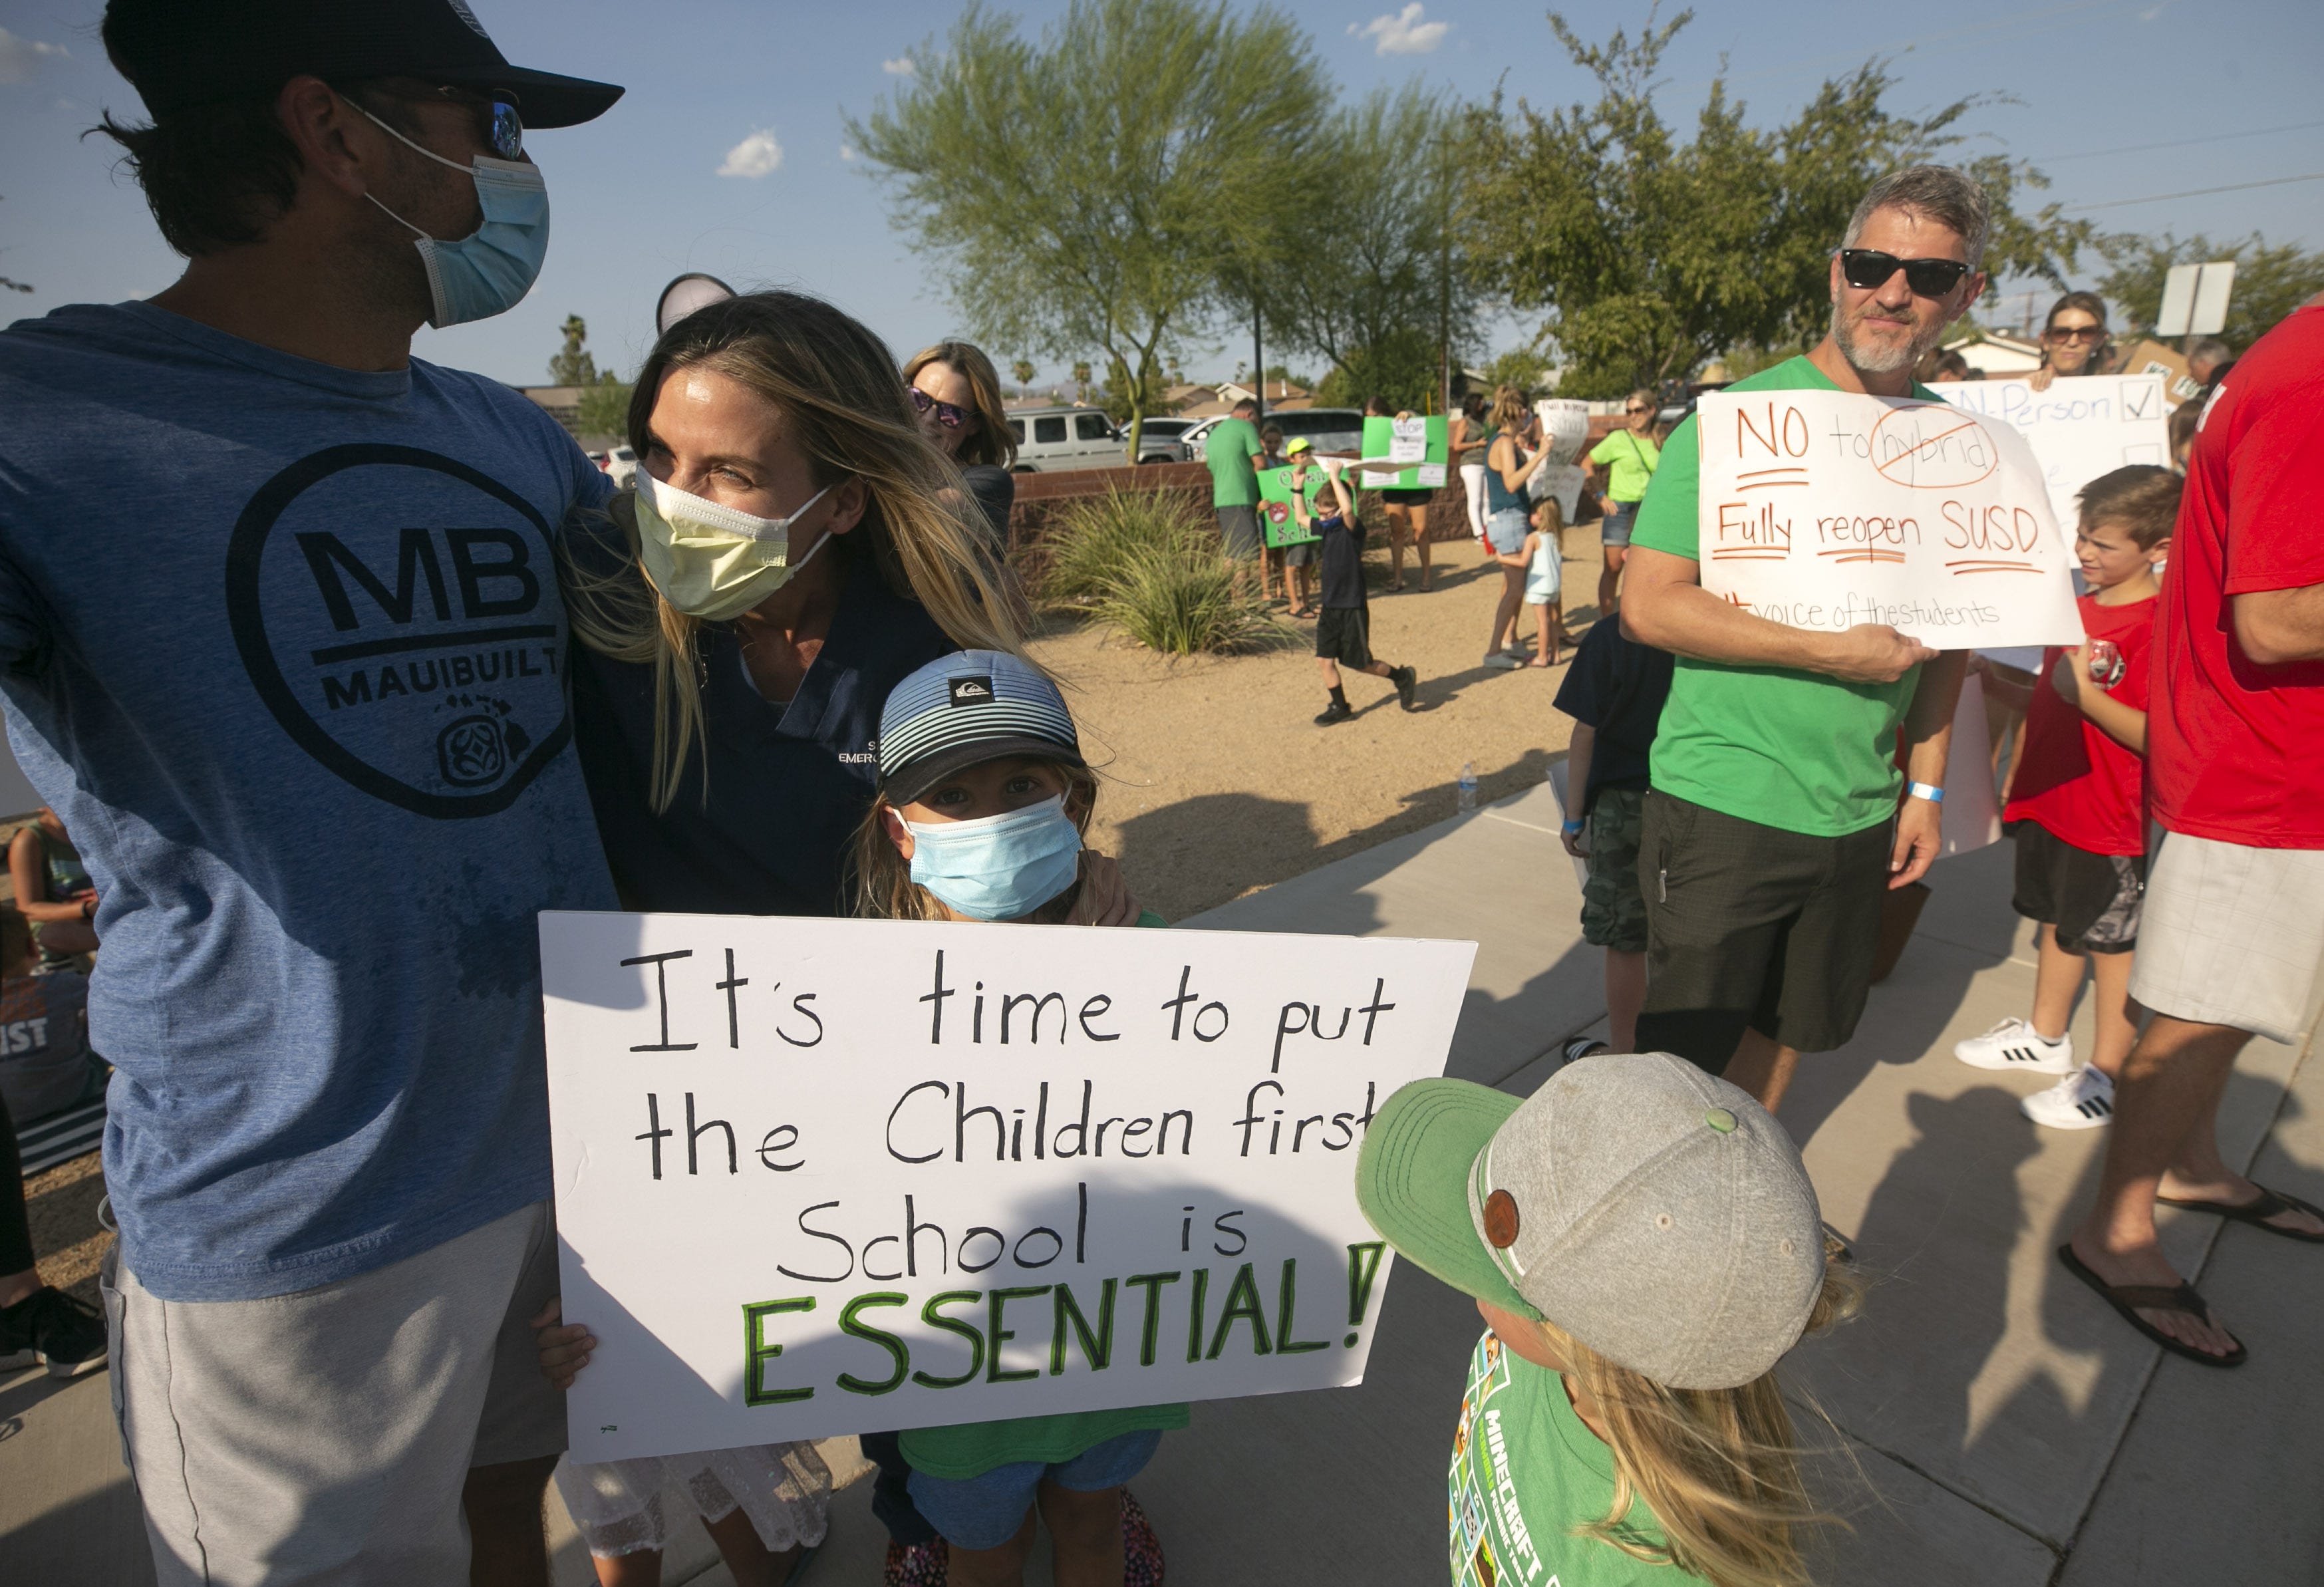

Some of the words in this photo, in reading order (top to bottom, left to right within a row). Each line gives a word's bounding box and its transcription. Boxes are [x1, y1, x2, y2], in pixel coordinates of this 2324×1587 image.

[1737, 401, 1809, 458] NO
[1829, 414, 1871, 457] to
[1938, 383, 2110, 426] N-Person
[1278, 470, 1326, 488] Oen
[294, 527, 540, 631] MB
[1719, 502, 1792, 555] Fully
[1817, 515, 1922, 563] reopen
[321, 646, 557, 710] MAUIBUILT
[619, 947, 823, 1053] It's
[919, 948, 1121, 1046] time
[1161, 964, 1229, 1044] to
[1272, 977, 1396, 1074] put
[635, 1092, 806, 1181] the
[886, 1079, 1193, 1165] Children
[1232, 1080, 1377, 1158] first
[776, 1181, 1088, 1283] School
[1181, 1206, 1248, 1258] is
[741, 1241, 1385, 1408] ESSENTIAL!
[1485, 1409, 1543, 1582] MINECRAFT
